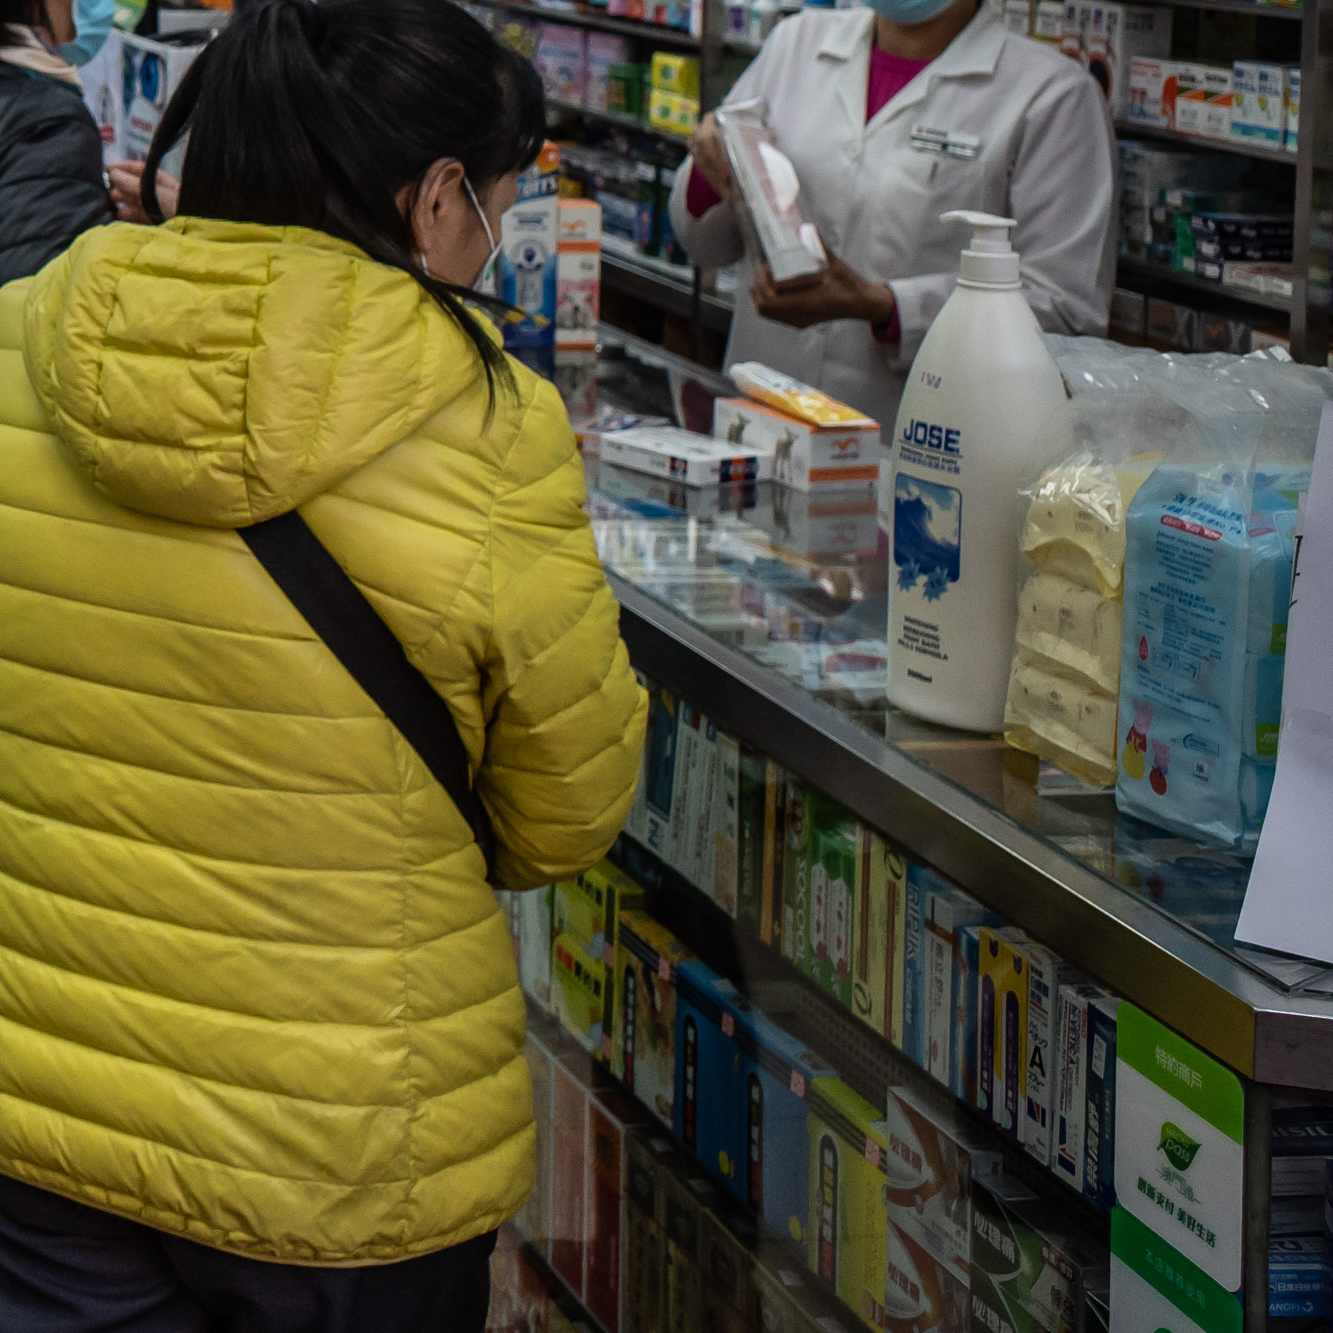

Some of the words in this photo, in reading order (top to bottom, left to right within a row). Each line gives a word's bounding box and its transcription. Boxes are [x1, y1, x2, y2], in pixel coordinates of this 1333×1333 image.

[903, 418, 962, 453] JOSE
[1030, 1044, 1046, 1078] A
[1163, 1138, 1191, 1164] pass
[974, 1210, 1015, 1264] 必理痛
[1177, 1207, 1217, 1248] 美好生活
